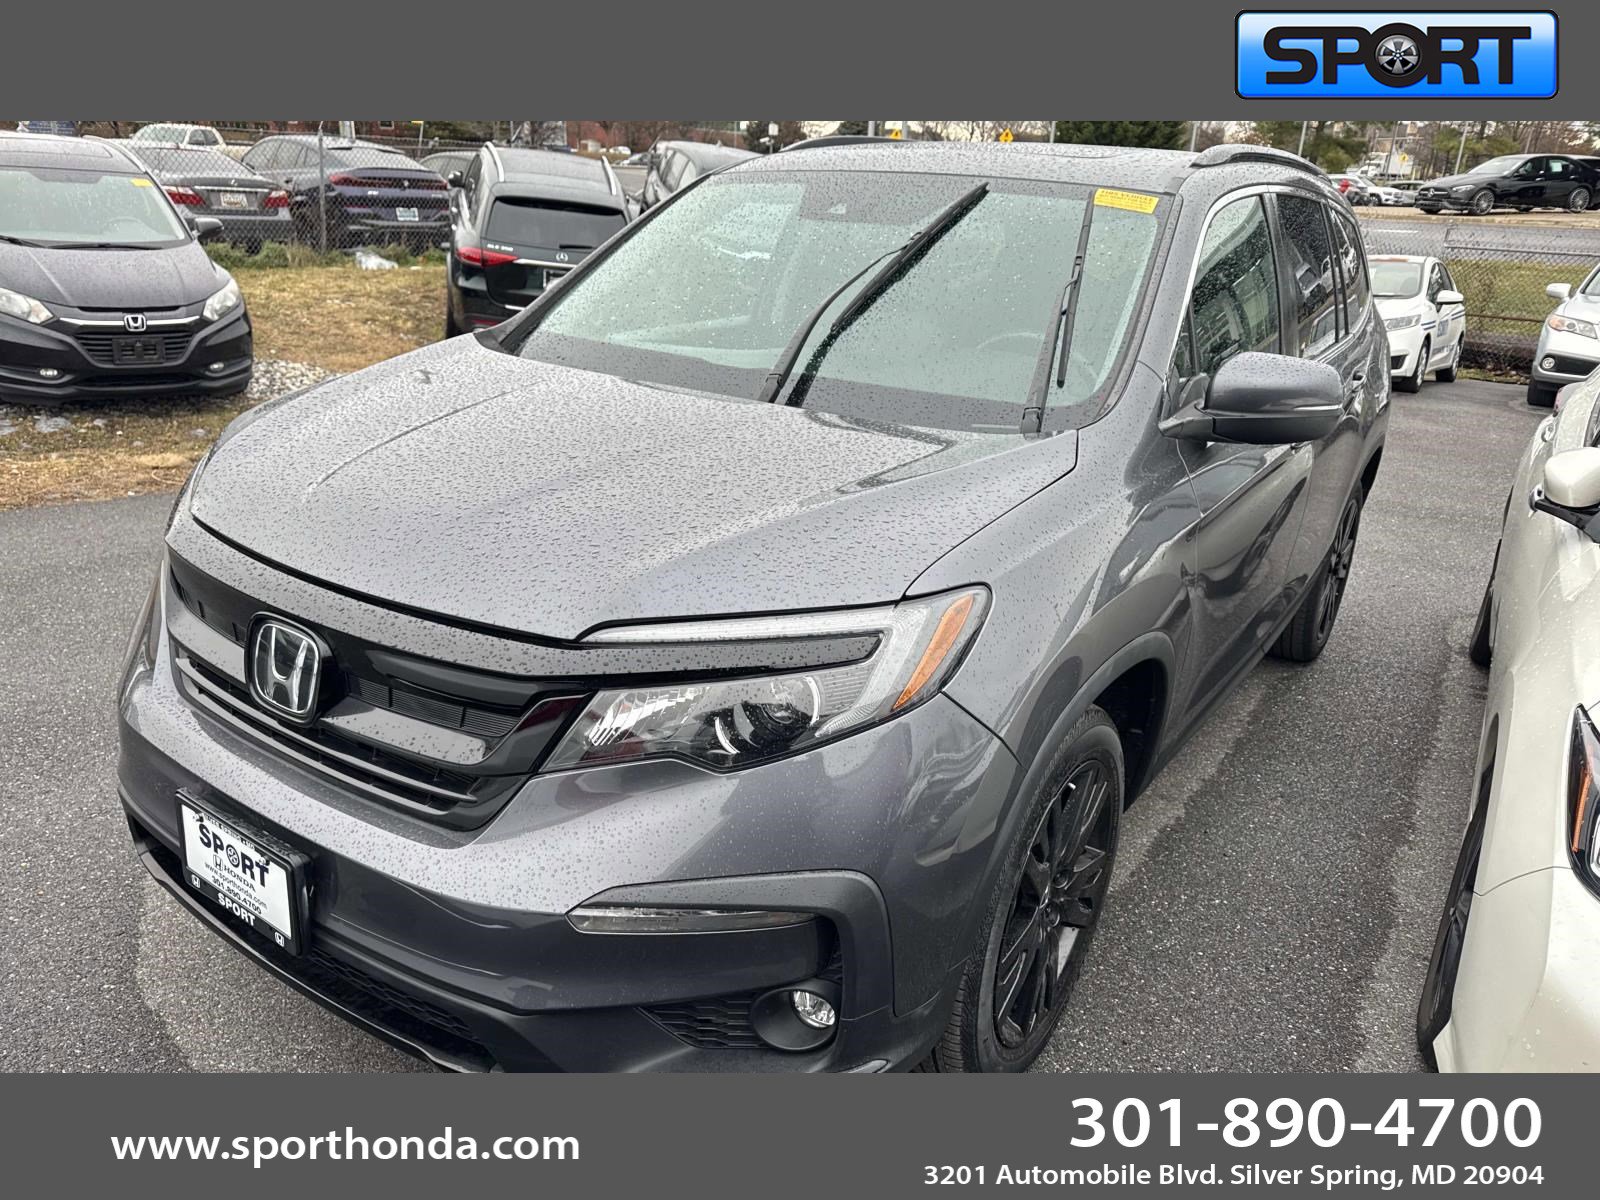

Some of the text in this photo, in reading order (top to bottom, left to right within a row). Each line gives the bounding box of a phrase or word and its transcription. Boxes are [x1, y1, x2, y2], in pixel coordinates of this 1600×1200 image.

[198, 823, 270, 888] SPORT
[224, 864, 256, 893] HONDA
[217, 892, 256, 927] SPORT
